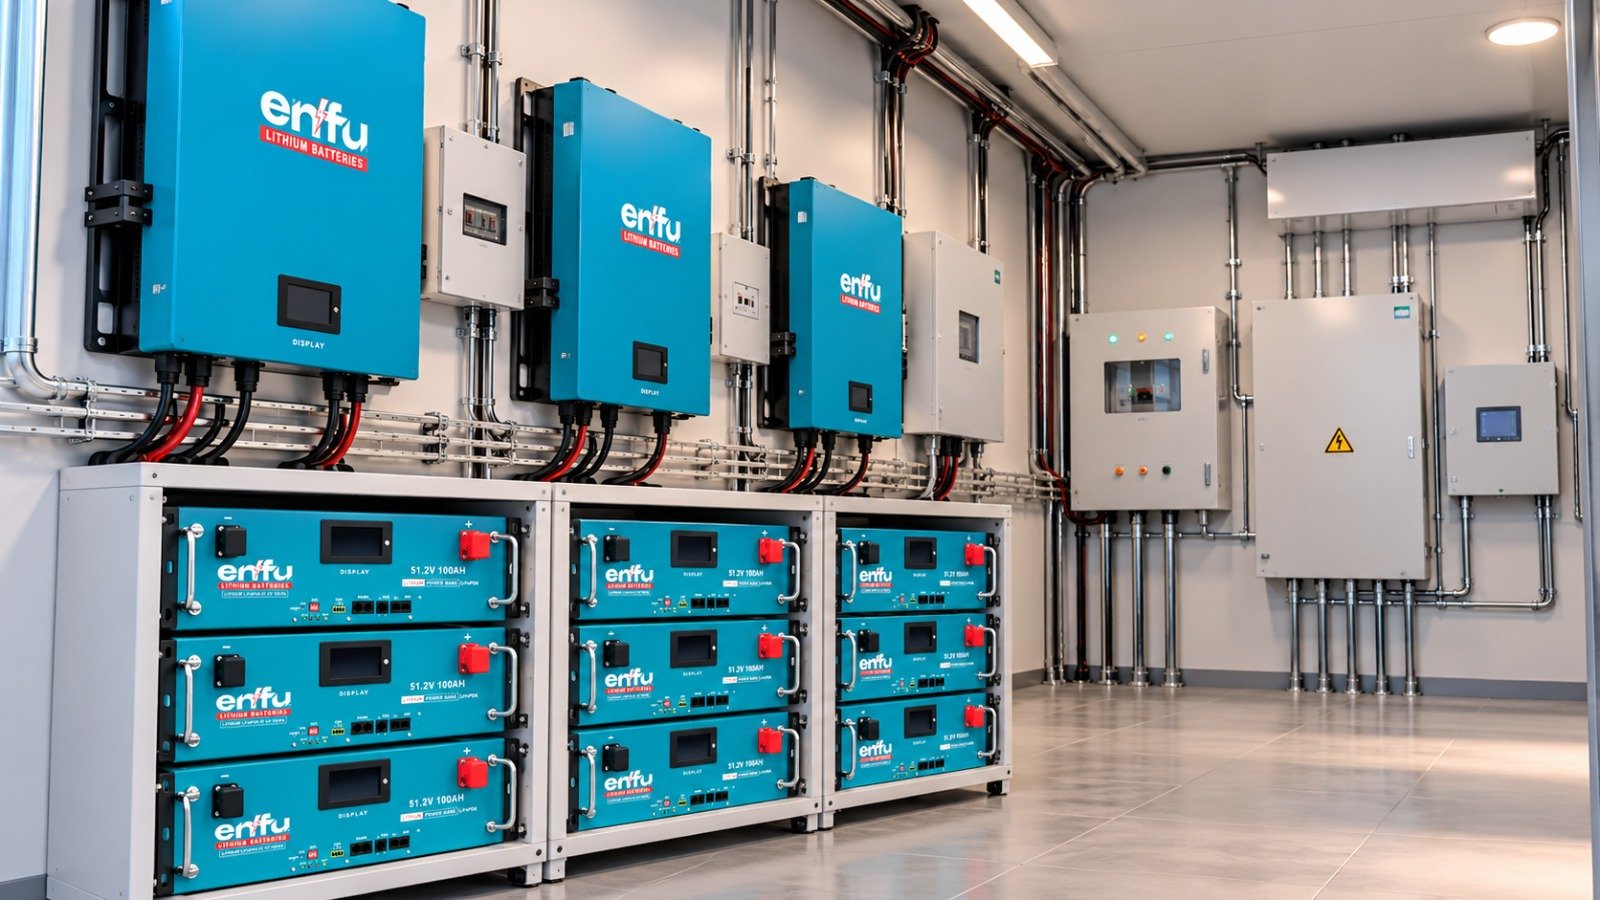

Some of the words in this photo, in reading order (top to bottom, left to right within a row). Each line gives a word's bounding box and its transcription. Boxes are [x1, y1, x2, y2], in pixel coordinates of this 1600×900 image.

[265, 129, 308, 152] LITHIUM
[311, 144, 364, 168] BATTERIES
[292, 338, 325, 349] DISPLAY
[410, 565, 436, 575] 51.2V
[437, 565, 466, 575] 100AH
[410, 681, 435, 691] 51.2V
[437, 679, 466, 689] 100AH
[409, 797, 434, 808] 51.2V
[436, 793, 464, 804] 100AH
[338, 810, 369, 819] DISPLAY
